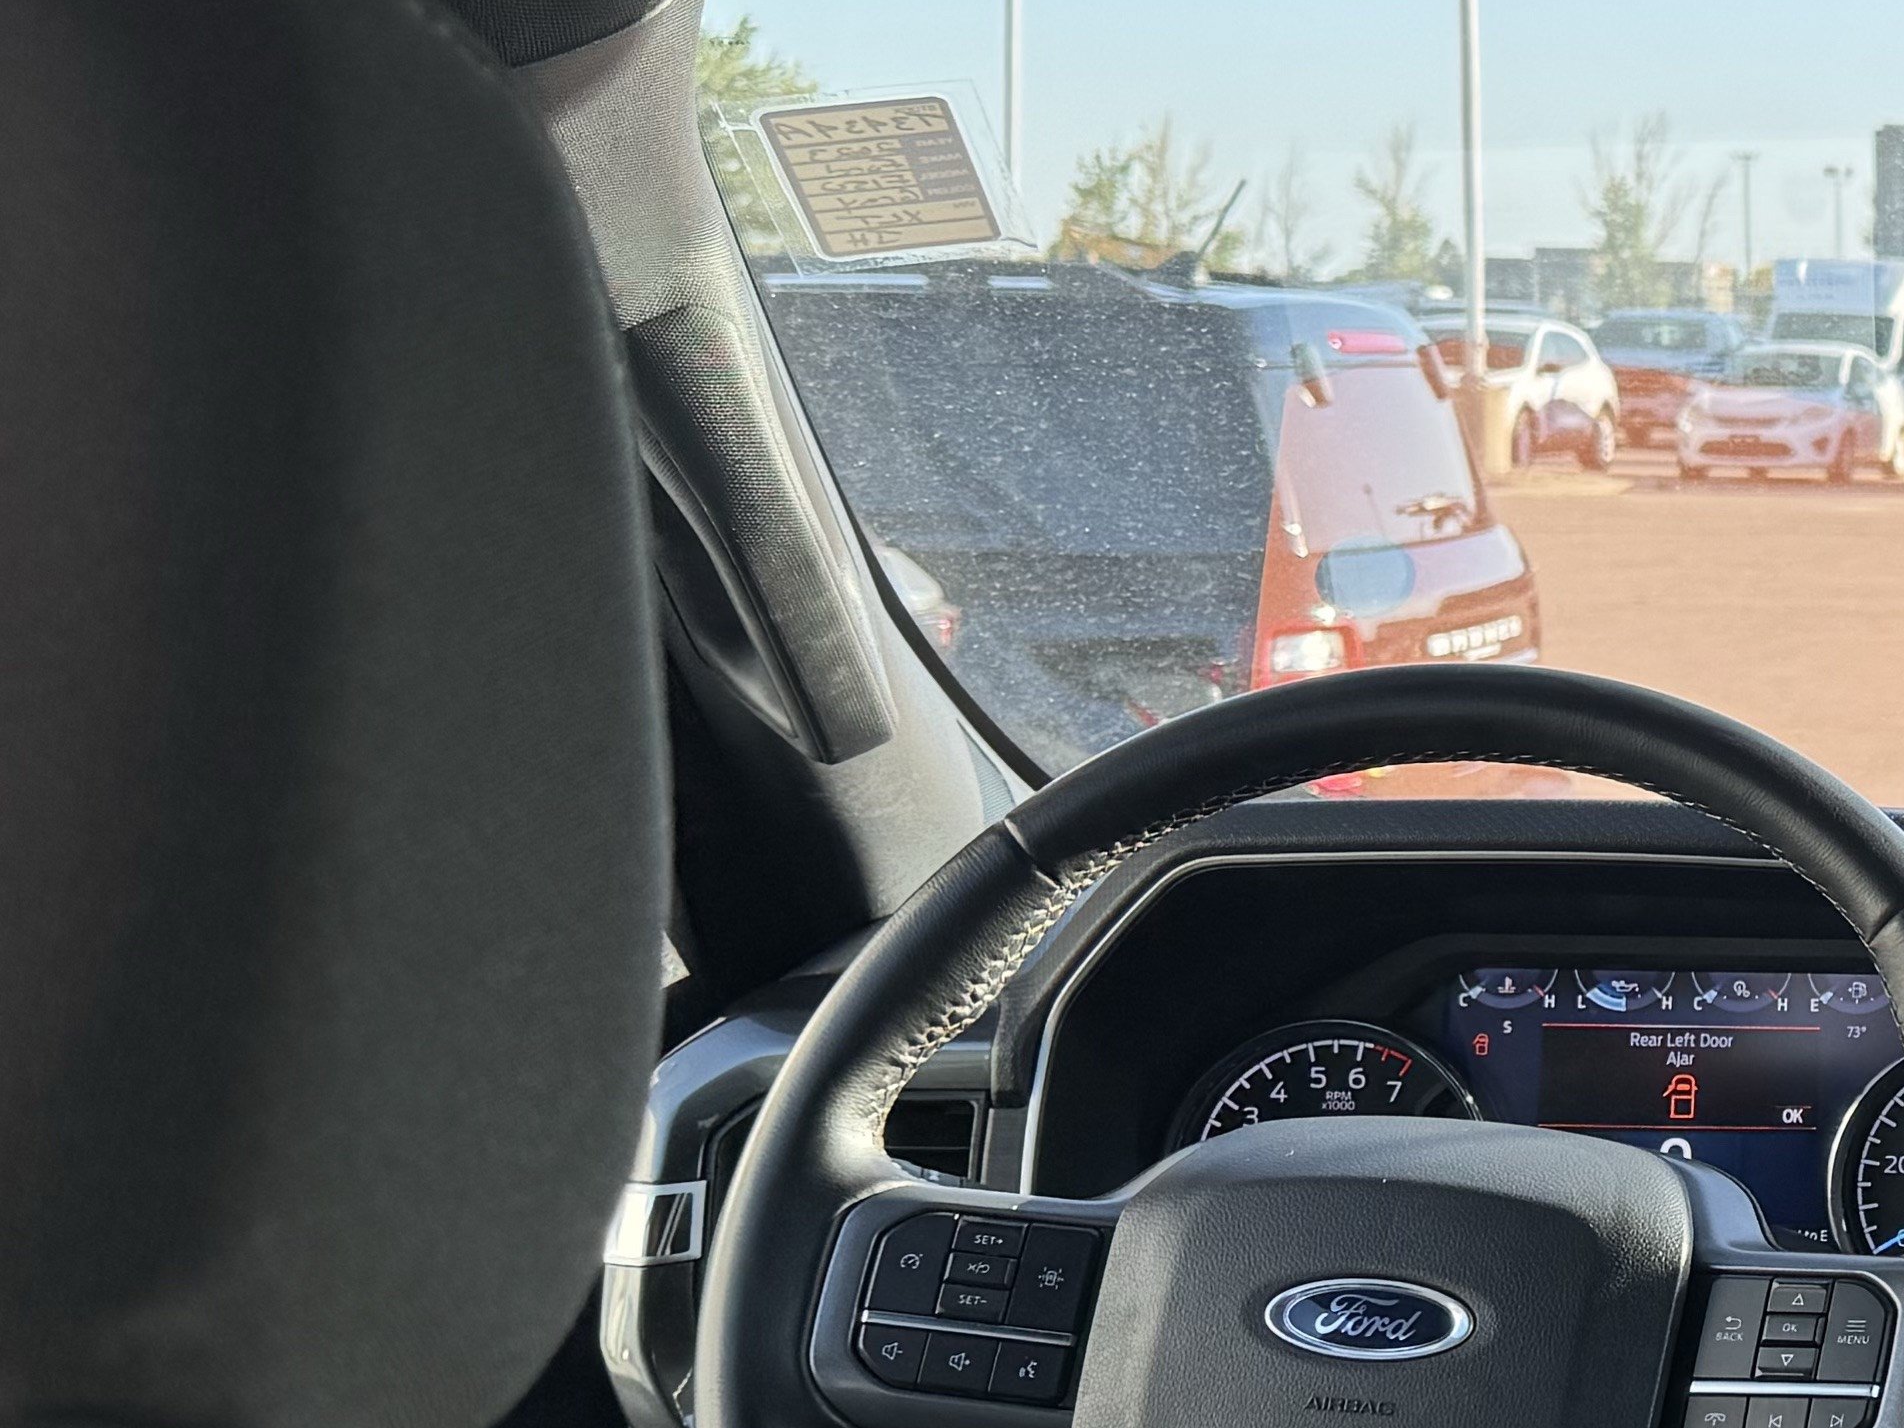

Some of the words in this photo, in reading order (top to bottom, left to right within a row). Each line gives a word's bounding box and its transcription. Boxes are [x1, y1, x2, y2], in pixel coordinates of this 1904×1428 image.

[1459, 994, 1469, 1008] C
[1544, 994, 1555, 1009] H
[1577, 995, 1587, 1009] L
[1662, 996, 1673, 1010] H
[1777, 997, 1788, 1012] H
[1810, 998, 1819, 1012] E
[1503, 1020, 1512, 1034] S
[1846, 1025, 1867, 1039] 73°
[1630, 1032, 1663, 1047] Rear
[1667, 1032, 1696, 1048] Left
[1700, 1033, 1733, 1049] Door
[1666, 1050, 1695, 1068] Ajar
[1310, 1067, 1327, 1089] 5
[1348, 1068, 1366, 1089] 6
[1269, 1081, 1288, 1103] 4
[1326, 1091, 1351, 1101] RPM
[1386, 1080, 1402, 1103] 7
[1322, 1100, 1355, 1111] x1000
[1243, 1107, 1259, 1125] 3
[1782, 1108, 1804, 1125] OK
[1314, 1293, 1422, 1341] Ford
[1782, 1323, 1798, 1332] OK
[1716, 1332, 1744, 1341] BACK
[1837, 1335, 1870, 1345] MENU
[1303, 1395, 1397, 1416] AIRBAG
